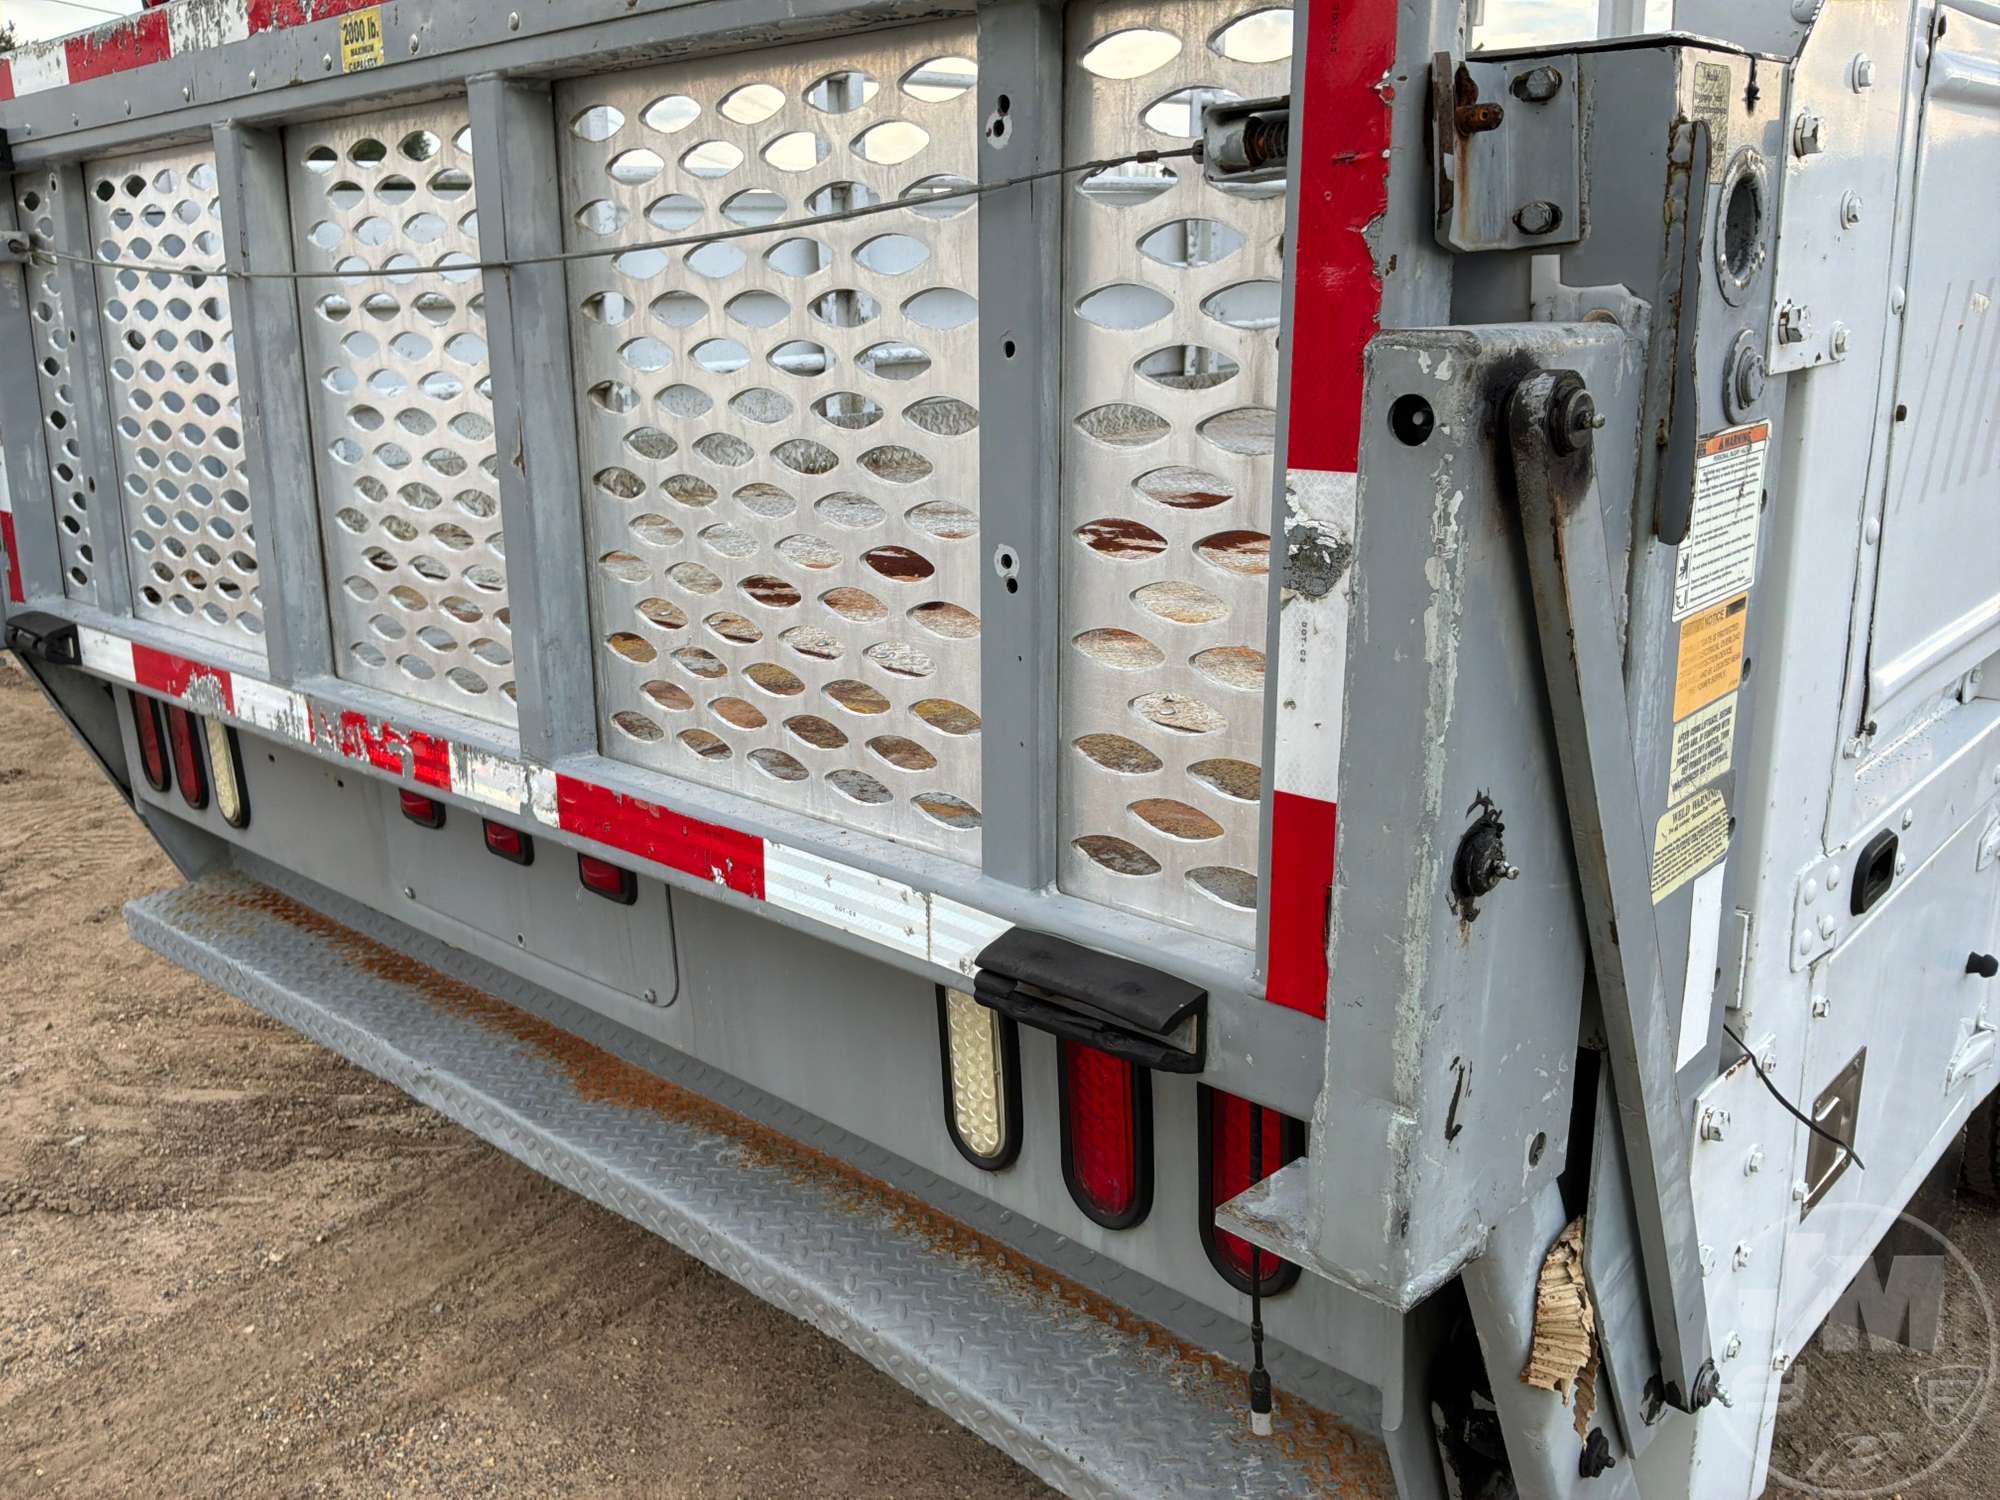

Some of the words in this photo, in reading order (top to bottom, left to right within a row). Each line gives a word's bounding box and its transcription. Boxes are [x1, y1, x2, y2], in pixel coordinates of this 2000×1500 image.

[343, 19, 365, 45] 2000
[367, 16, 379, 39] lb.
[351, 44, 374, 57] MAXIMUM
[1725, 431, 1751, 448] WARNING
[1704, 608, 1725, 624] NOTICE
[1299, 621, 1308, 663] DOT-C2
[1672, 804, 1690, 823] WELD
